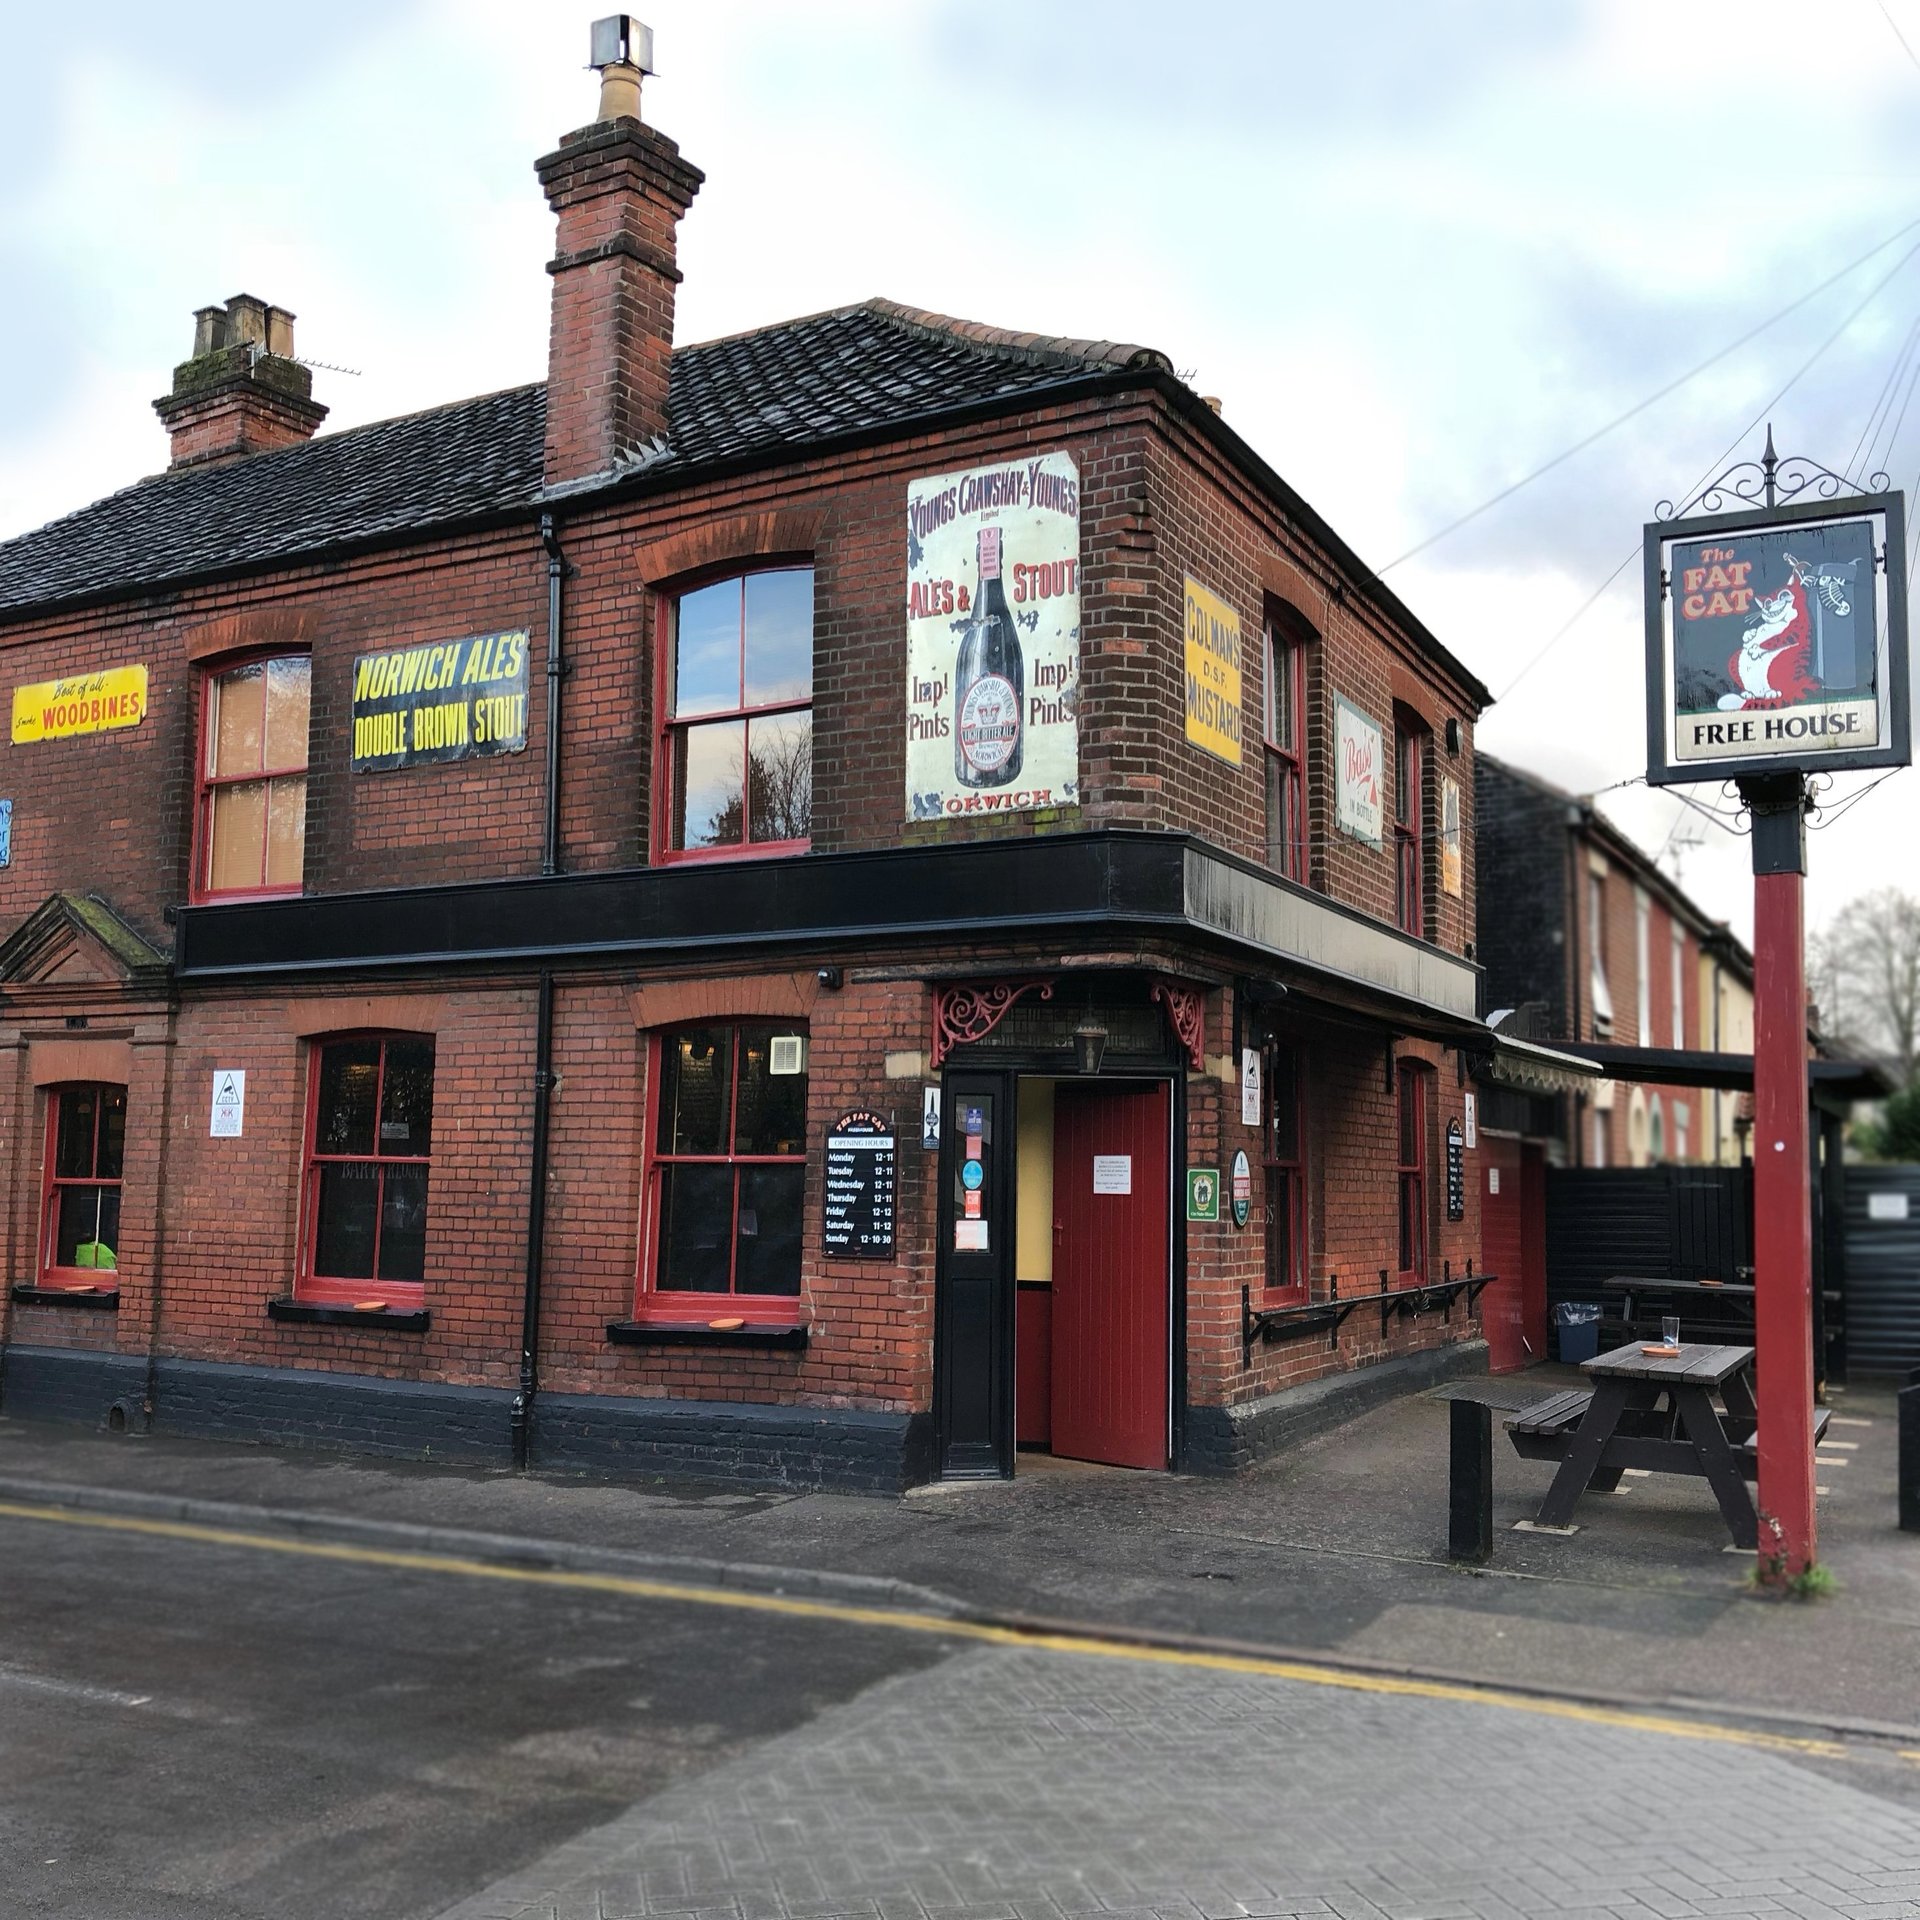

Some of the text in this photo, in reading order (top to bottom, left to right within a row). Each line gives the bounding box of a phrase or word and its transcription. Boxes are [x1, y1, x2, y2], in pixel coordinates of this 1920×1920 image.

[909, 487, 956, 539] YOUNGS
[958, 470, 1025, 516] CRAWSHAY
[1021, 481, 1029, 496] &
[1702, 548, 1735, 563] The
[909, 580, 954, 620] ALES
[957, 586, 971, 611] &
[1013, 558, 1077, 603] STOUT
[1683, 562, 1752, 594] FAT
[1682, 587, 1754, 621] CAT
[1187, 595, 1240, 671] COLMAN'S
[354, 633, 526, 702] NORWICH ALES
[1034, 655, 1073, 692] Imp!
[1203, 660, 1227, 689] D.S.F.
[52, 684, 76, 701] Best
[78, 680, 88, 700] of
[913, 673, 948, 708] Imp!
[43, 692, 139, 730] WOODBINES
[1187, 671, 1240, 743] MUSTARD
[355, 694, 526, 760] DOUBLE BROWN STOUT
[908, 712, 949, 742] Pints
[1002, 725, 1014, 739] ALE
[1694, 712, 1861, 746] FREE HOUSE
[1356, 802, 1373, 825] BOTTLE
[853, 1112, 870, 1121] FAT
[828, 1152, 855, 1164] Monday
[828, 1166, 854, 1177] Tuesday
[827, 1180, 865, 1191] Wednesday
[827, 1193, 857, 1204] Thursday
[826, 1207, 847, 1217] Friday
[826, 1220, 854, 1231] Saturday
[825, 1234, 849, 1245] Sunday
